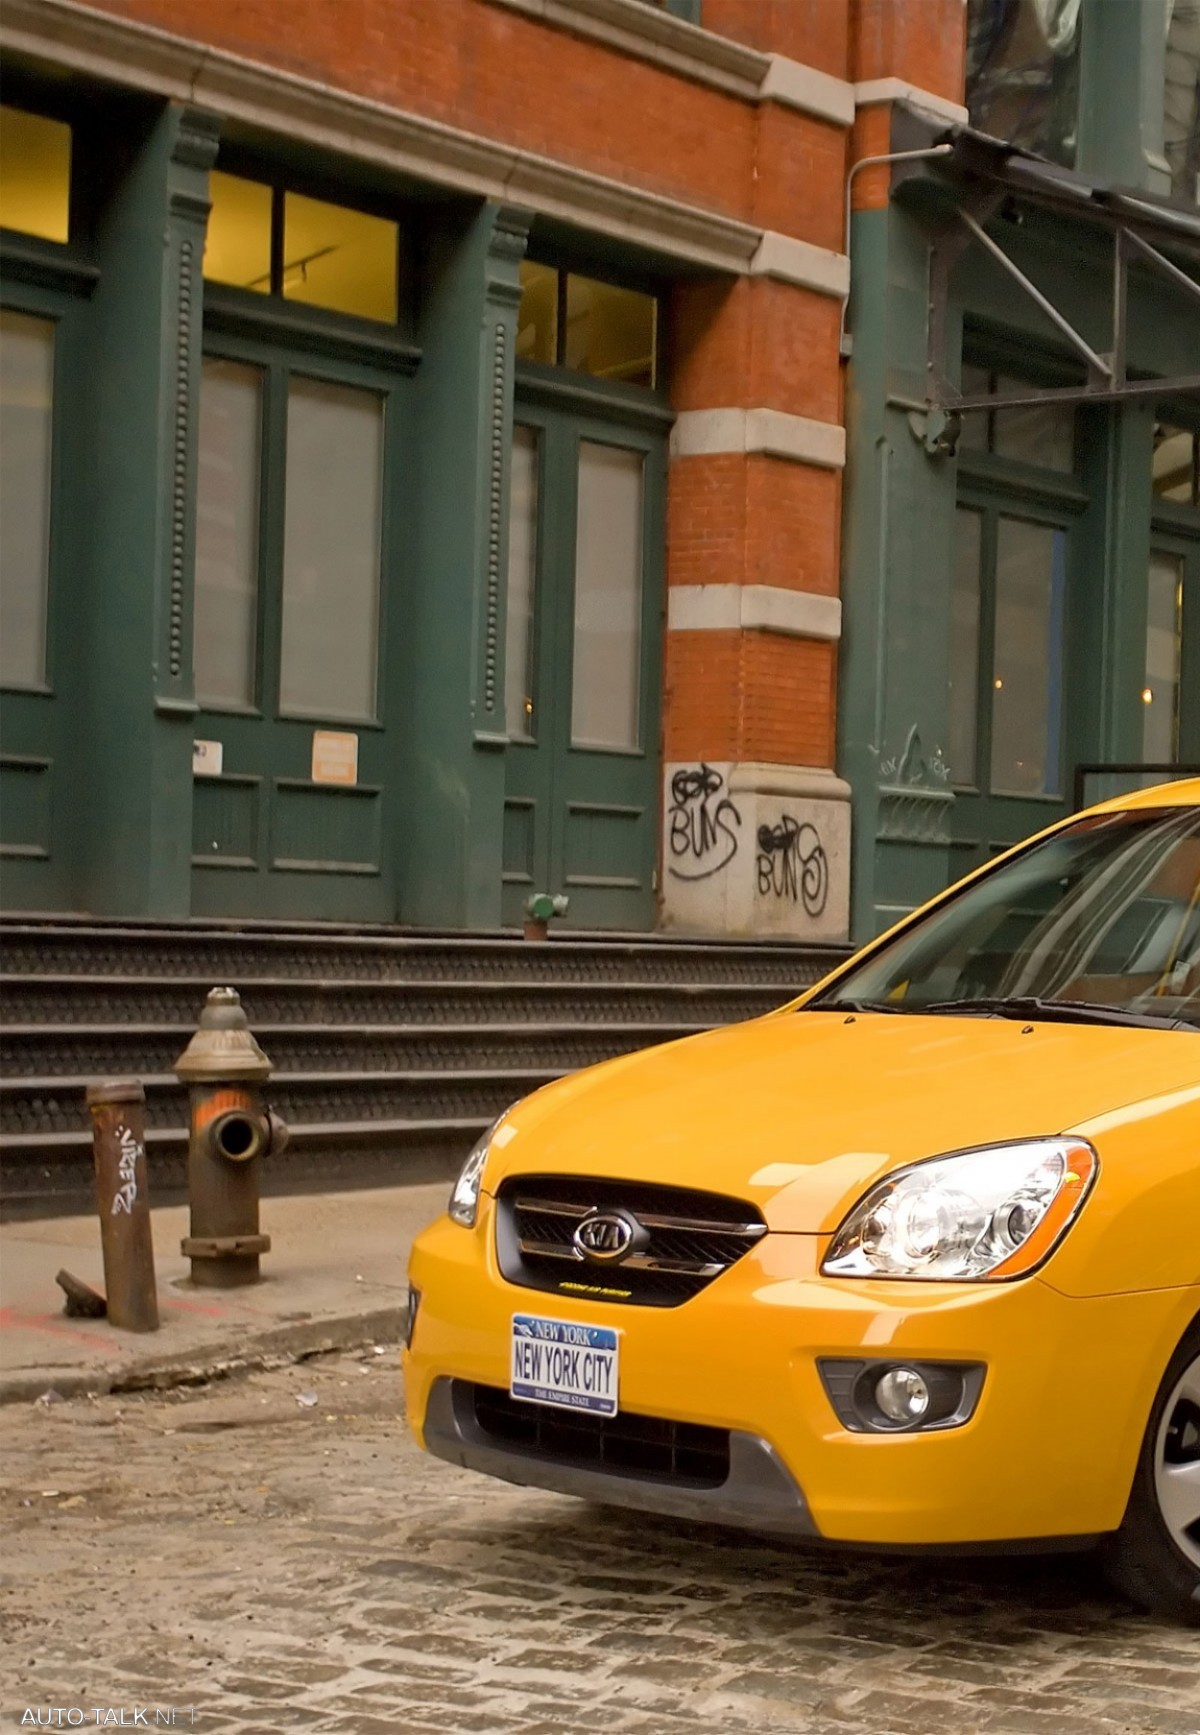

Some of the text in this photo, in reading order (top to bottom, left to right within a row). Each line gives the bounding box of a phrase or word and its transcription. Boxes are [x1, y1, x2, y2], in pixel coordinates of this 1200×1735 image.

[668, 799, 742, 882] BUNS
[534, 1320, 591, 1346] NEW YORK
[515, 1340, 613, 1393] NEW YORK CITY
